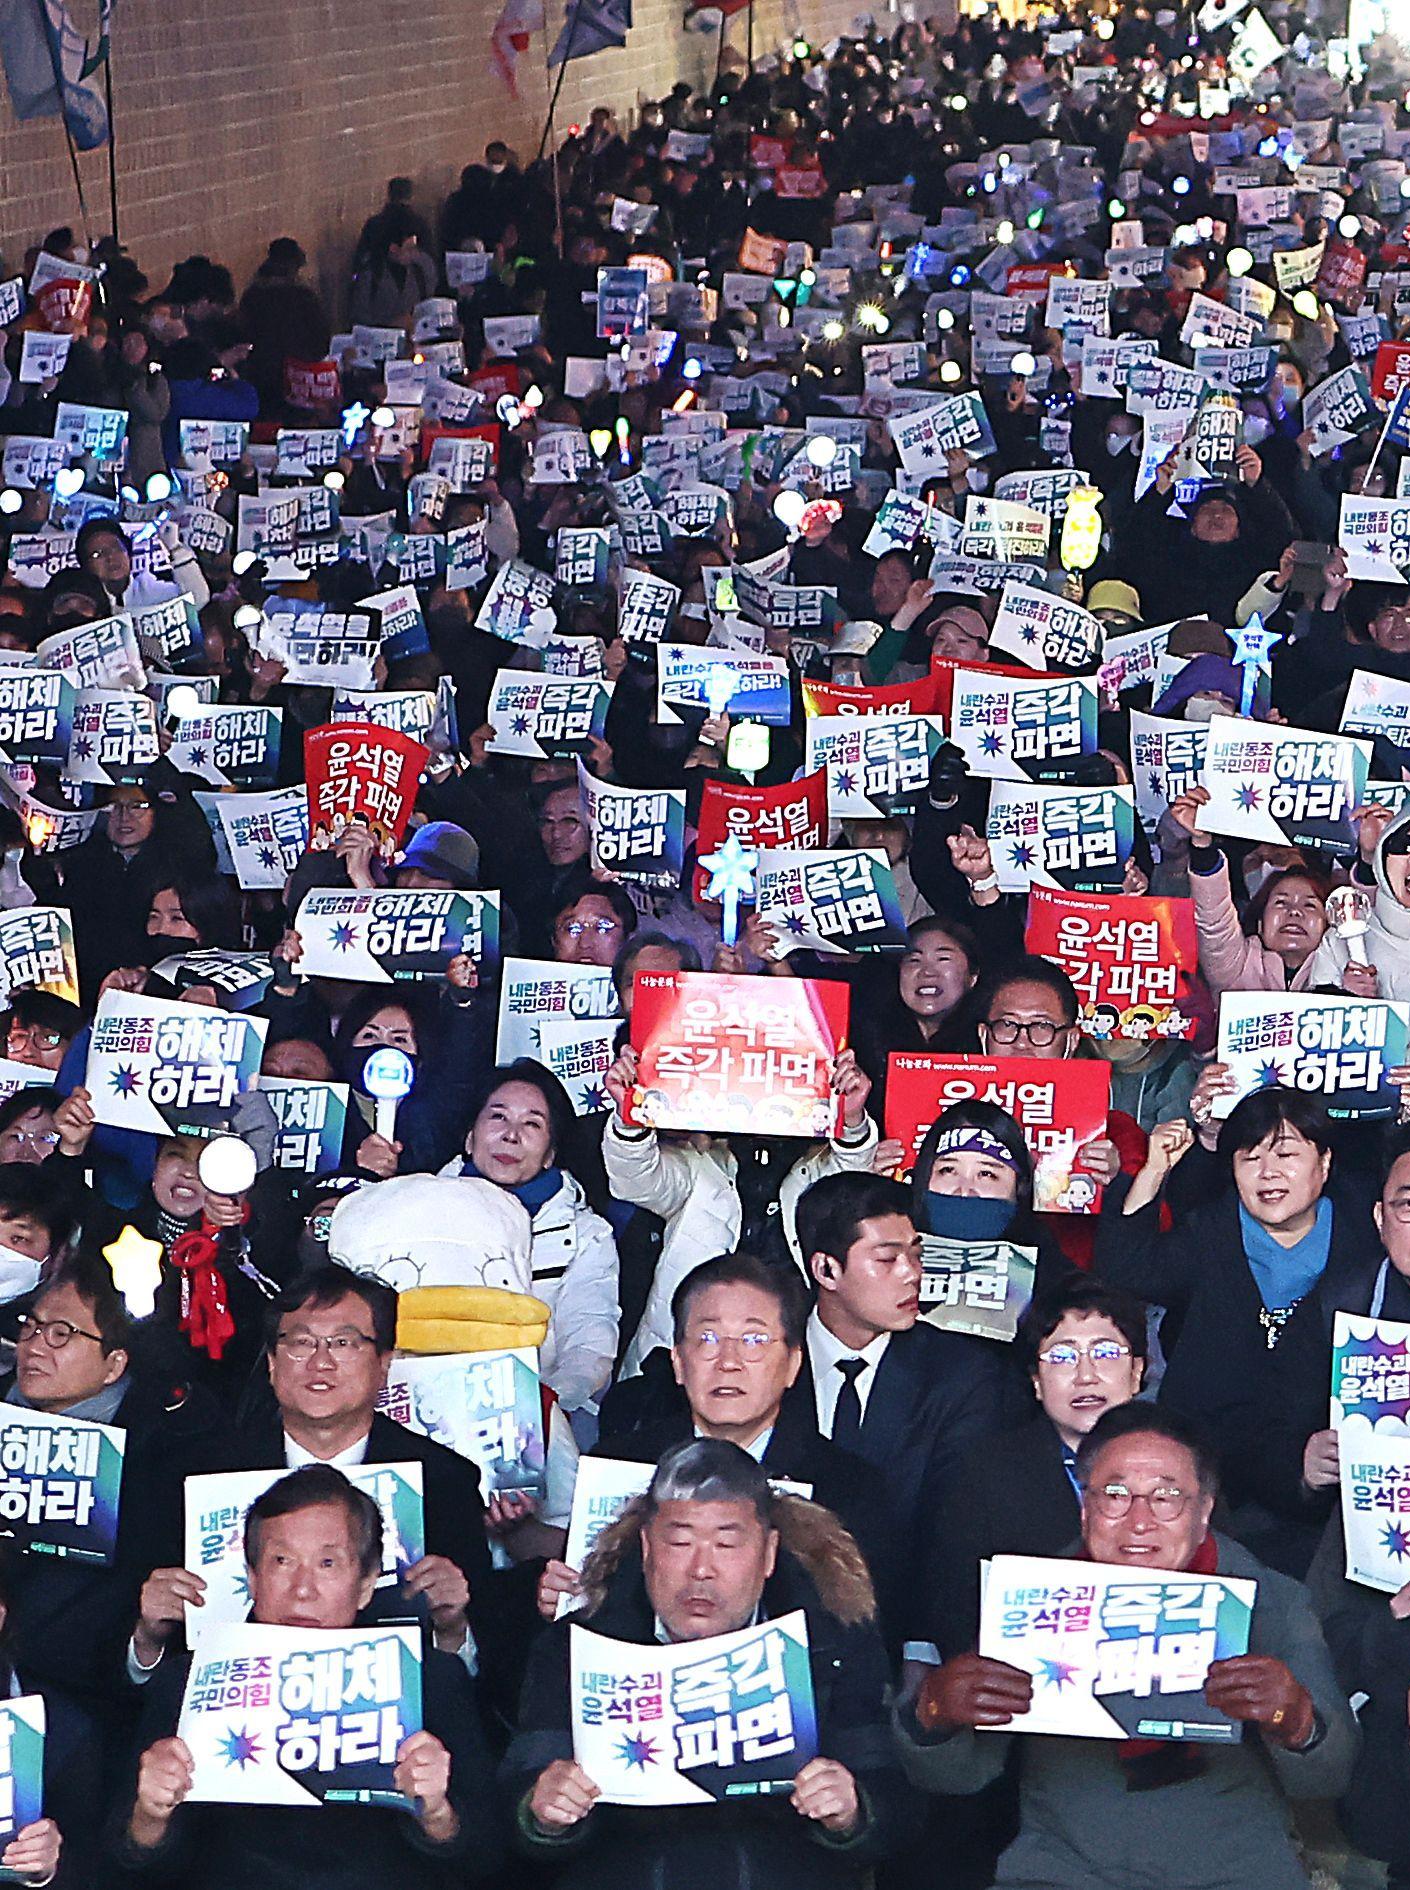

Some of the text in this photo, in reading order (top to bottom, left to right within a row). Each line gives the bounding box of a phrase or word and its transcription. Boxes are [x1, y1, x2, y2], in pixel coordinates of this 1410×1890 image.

[1199, 410, 1239, 437] 해체
[677, 510, 716, 526] 하라
[559, 534, 599, 560] 즉각
[543, 685, 598, 711] 즉각
[962, 694, 1010, 706] 내란수괴
[1014, 682, 1082, 724] 즉각
[216, 709, 268, 740] 해체
[216, 712, 267, 740] 해체
[961, 705, 1008, 726] 윤석열
[814, 731, 860, 750] 내란수괴
[865, 721, 928, 756] 즉각
[1213, 741, 1273, 758] 내란동조
[215, 741, 266, 768] 하라
[328, 741, 405, 786] 윤석열
[1213, 757, 1271, 774] 국민의힘
[865, 760, 930, 796] 파면
[319, 775, 402, 829] 즉각 파면
[600, 796, 667, 825] 해체
[989, 801, 1038, 819] 내란수괴
[726, 799, 810, 839] 윤석열
[988, 815, 1038, 840] 윤석열
[599, 828, 665, 860] 하라
[1046, 832, 1118, 869] 파면
[760, 870, 800, 887] 내란수괴
[805, 853, 873, 896] 즉각
[373, 892, 452, 918] 해체
[761, 885, 804, 909] 윤석열
[812, 899, 886, 935] 파면
[369, 919, 445, 955] 하라
[1058, 916, 1159, 963] 윤석열
[509, 981, 566, 997] 내란동조
[1108, 964, 1177, 1005] 파면
[509, 996, 565, 1013] 국민의힘
[96, 1017, 155, 1035] 내란동조
[1228, 1011, 1295, 1036] 내란동조
[93, 1034, 151, 1053] 국민의힘
[156, 1018, 248, 1065] 해체
[550, 1038, 609, 1063] 내란동조
[1228, 1030, 1293, 1054] 국민의힘
[550, 1055, 609, 1079] 국민의힘
[656, 1046, 817, 1094] 즉각 파면
[1297, 1052, 1383, 1093] 하라
[1341, 1354, 1410, 1376] 내란수괴
[1339, 1373, 1410, 1403] 윤석열
[0, 1478, 94, 1525] 하라
[1002, 1585, 1097, 1607] 내란수괴
[1100, 1583, 1223, 1635] 즉각
[1000, 1605, 1093, 1638] 윤석열
[195, 1655, 272, 1686] 내란동조
[279, 1637, 403, 1712] 해체
[1095, 1632, 1217, 1697] 파면
[189, 1683, 271, 1713] 국민의힘
[580, 1671, 662, 1696] 내란수괴
[276, 1712, 403, 1772] 하라
[675, 1703, 794, 1772] 파면
